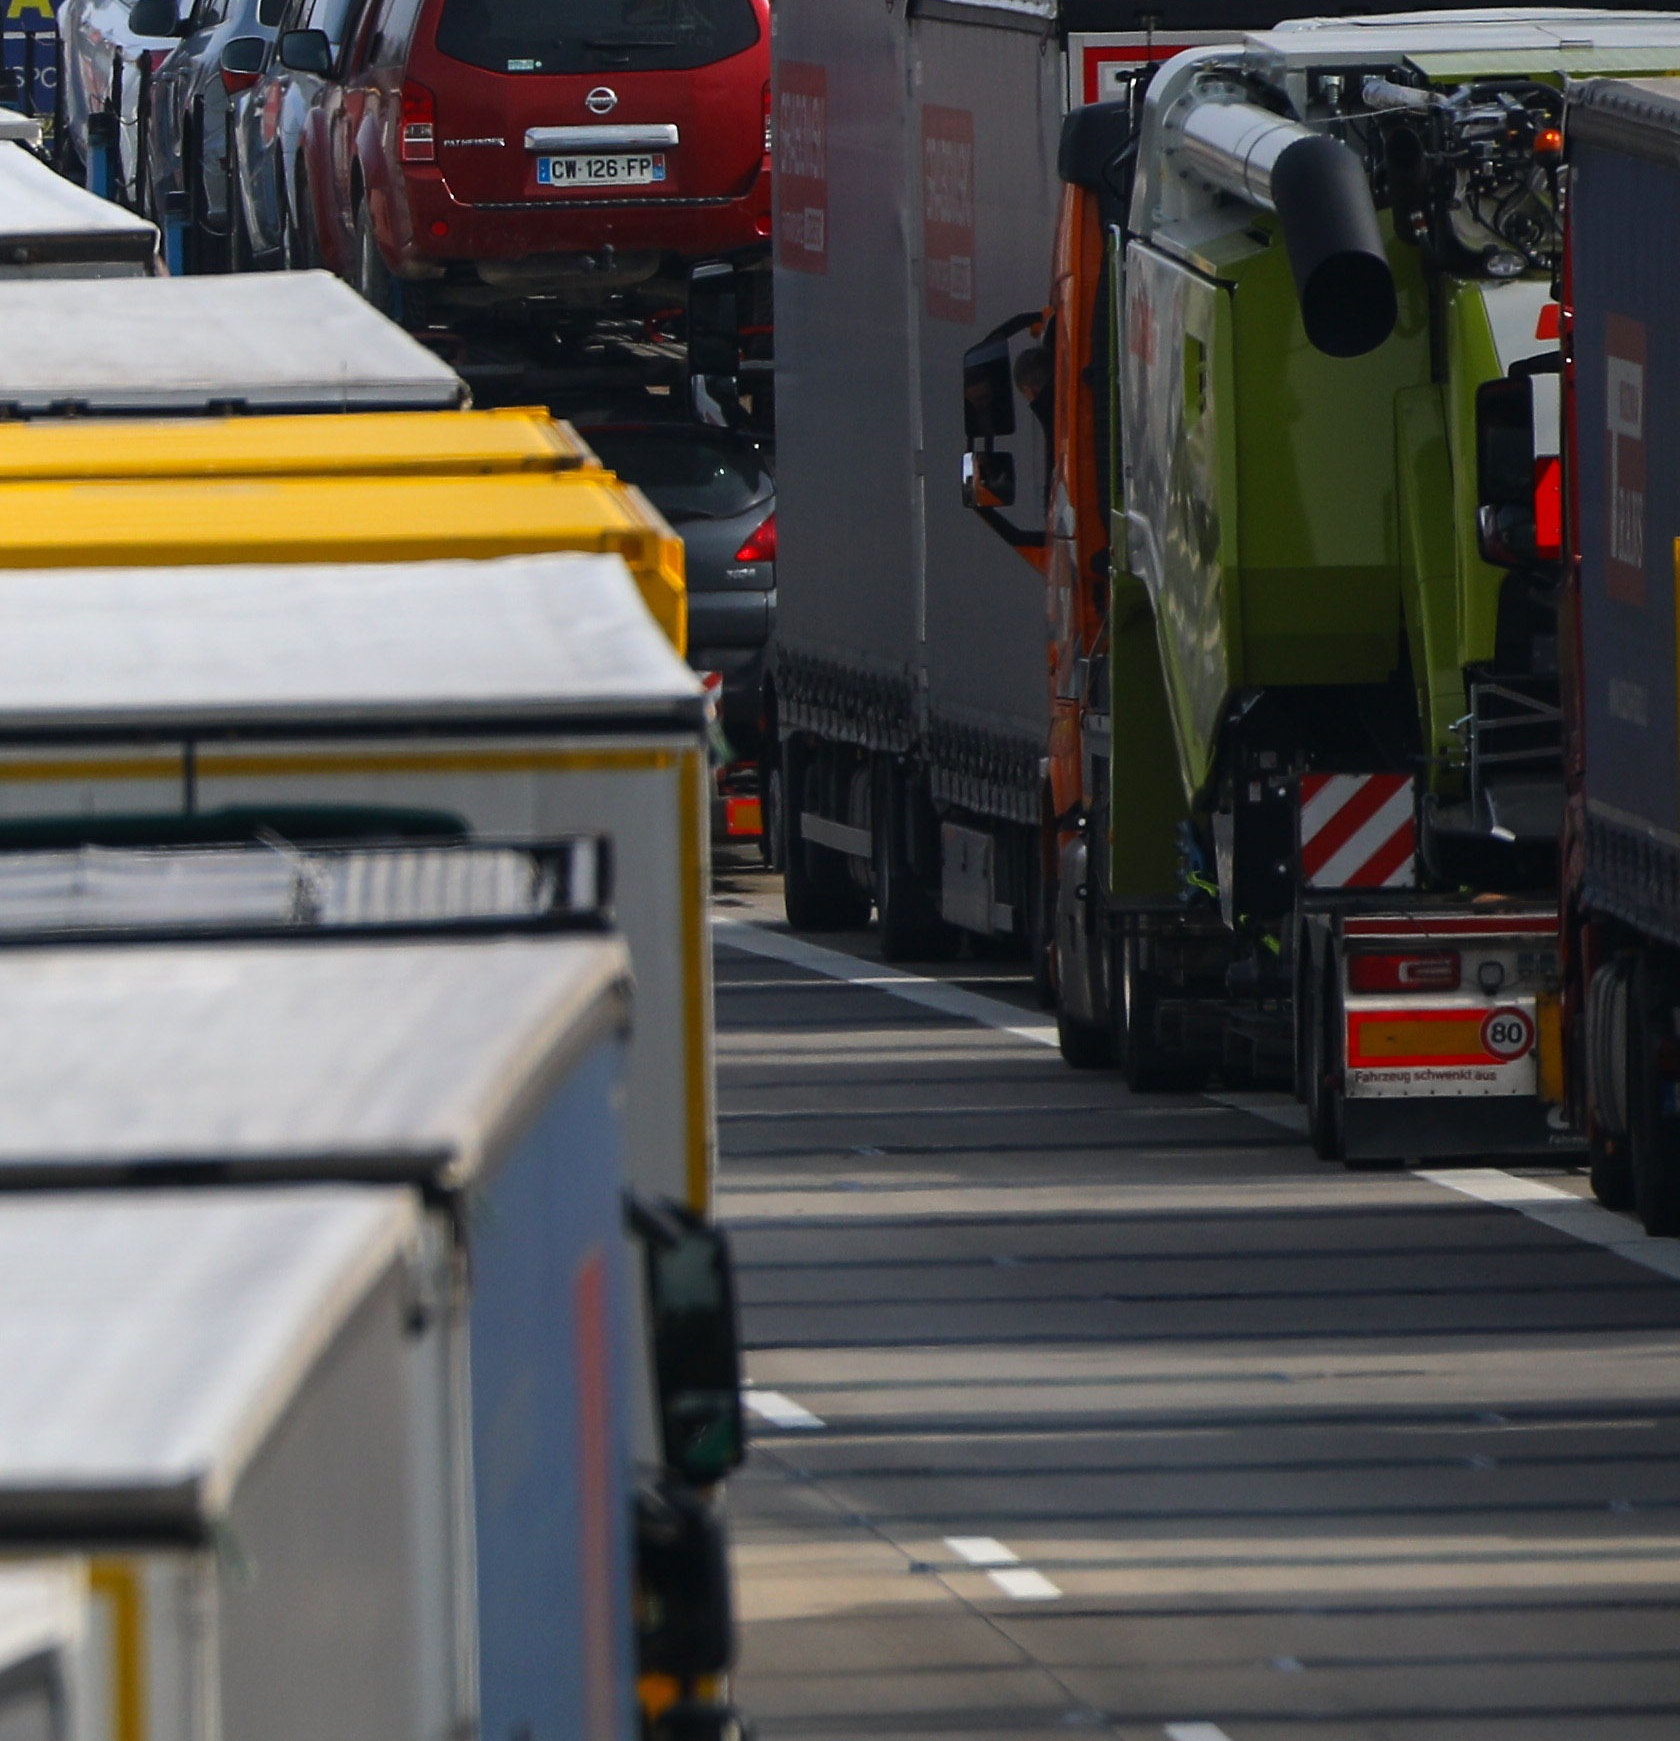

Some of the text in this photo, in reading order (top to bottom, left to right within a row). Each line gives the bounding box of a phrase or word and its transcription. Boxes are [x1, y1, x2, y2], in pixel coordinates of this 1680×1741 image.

[1490, 1022, 1524, 1044] 80
[1354, 1068, 1498, 1084] Fahrzeug schwenkt aus
